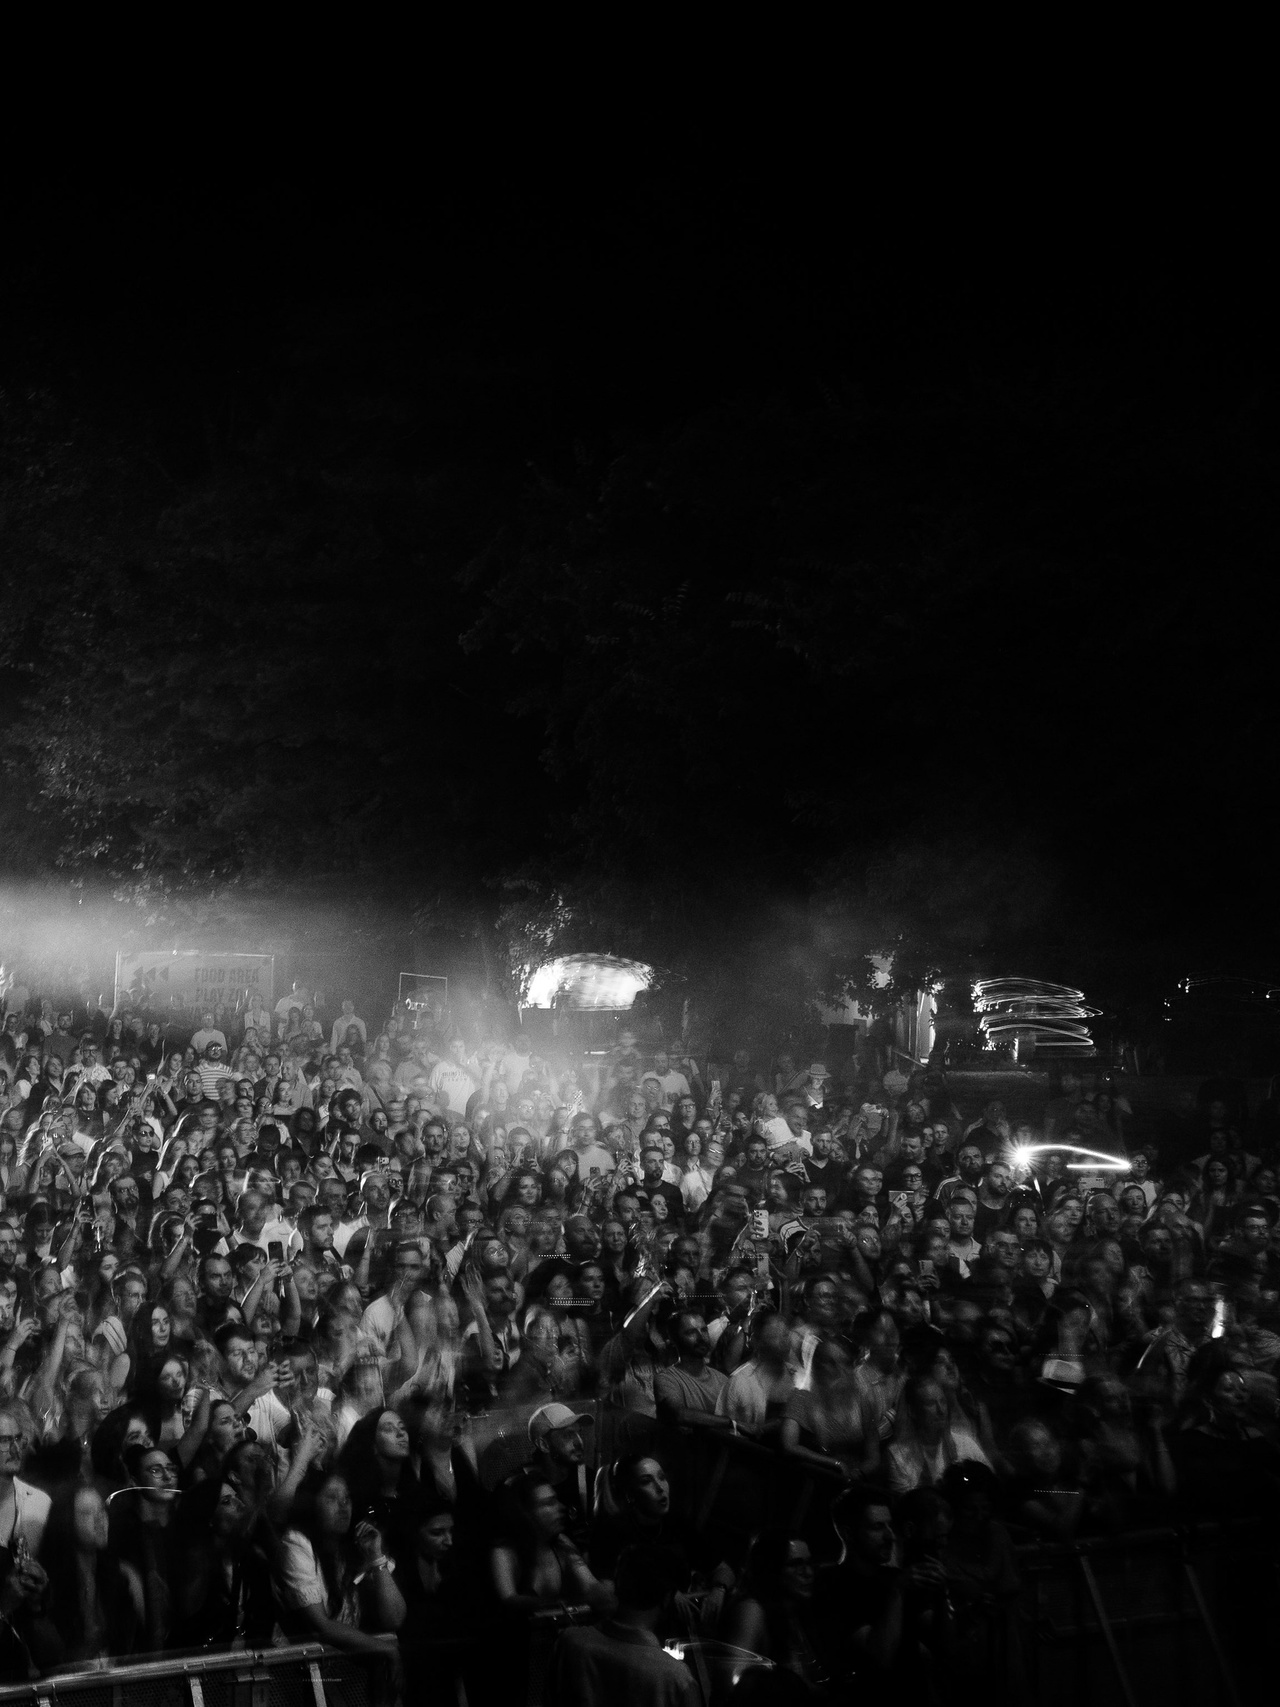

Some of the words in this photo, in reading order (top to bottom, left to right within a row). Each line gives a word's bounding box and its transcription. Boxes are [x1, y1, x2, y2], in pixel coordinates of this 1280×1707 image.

[194, 967, 226, 983] FOOD
[228, 967, 260, 983] AREA
[195, 987, 225, 1003] PLAY
